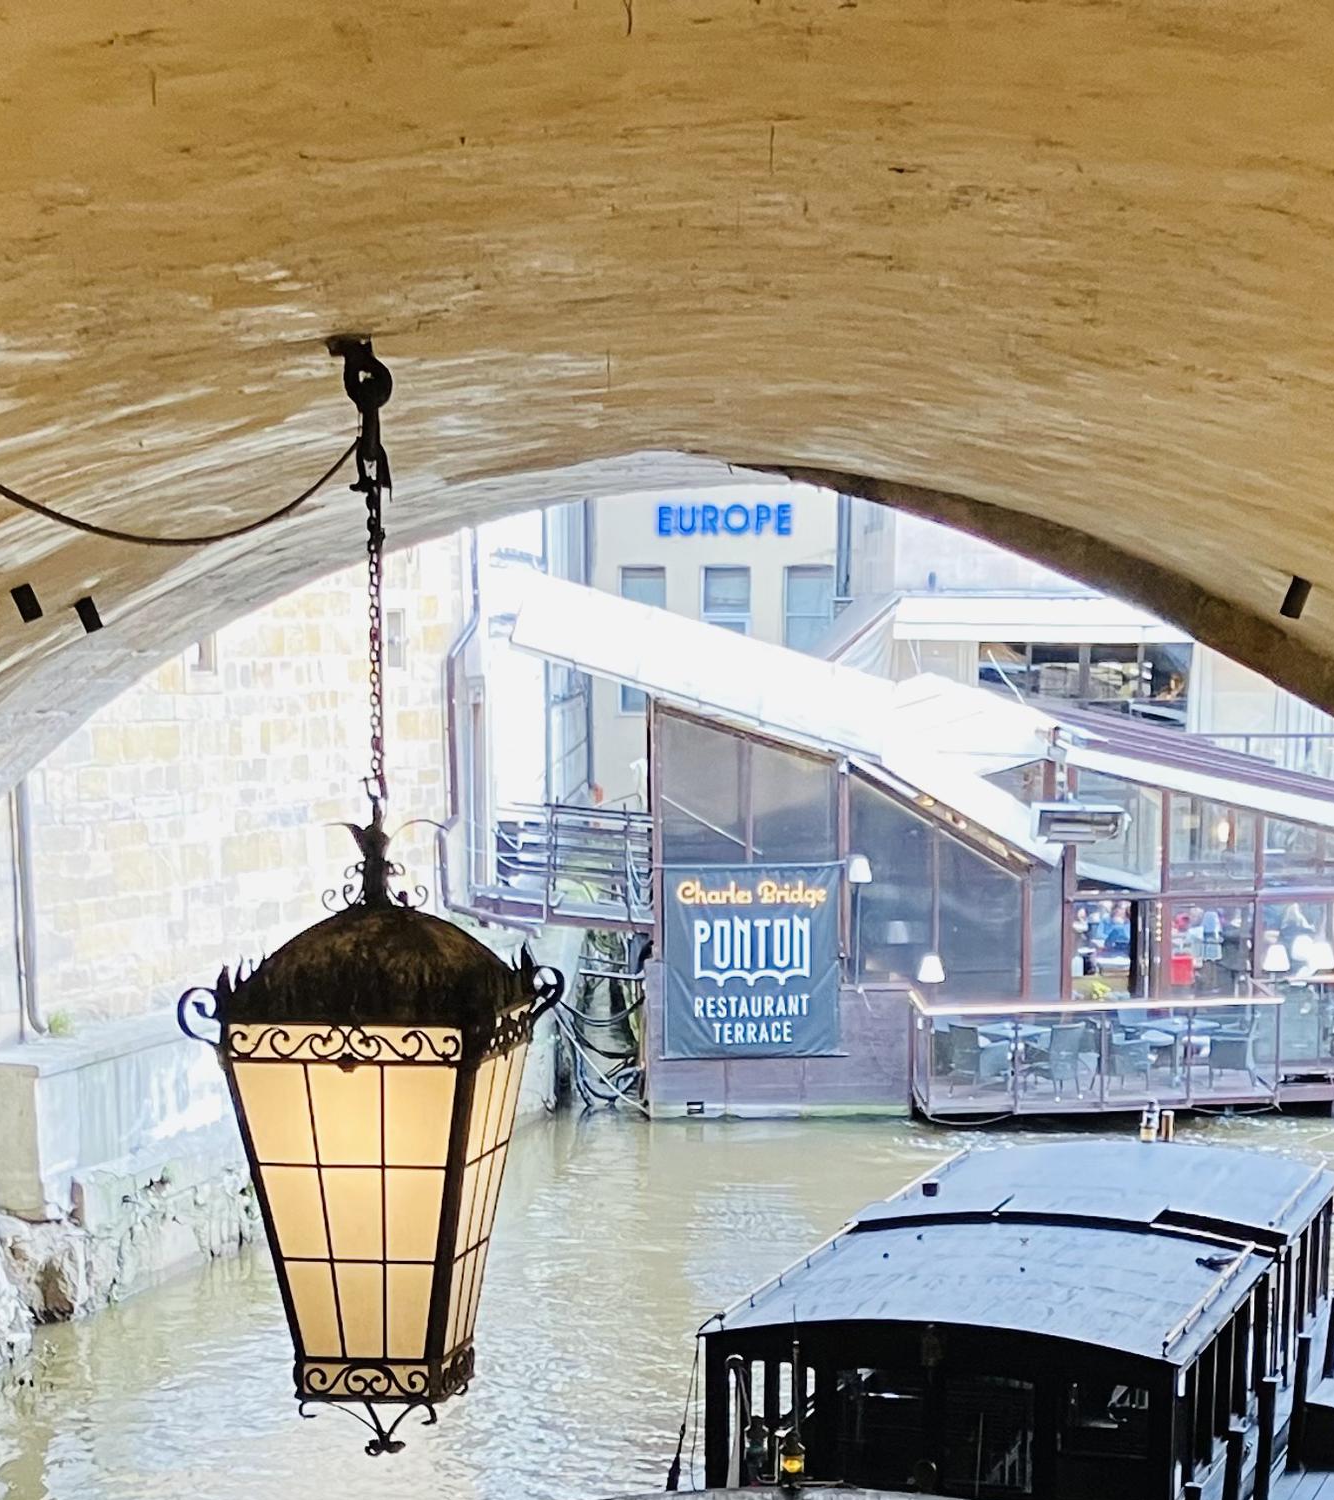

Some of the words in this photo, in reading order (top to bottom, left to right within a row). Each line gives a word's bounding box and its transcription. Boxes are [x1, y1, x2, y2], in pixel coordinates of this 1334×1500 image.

[657, 504, 793, 536] EUROPE
[677, 880, 753, 905] Charles
[758, 880, 827, 908] Bridge
[693, 914, 811, 979] PONTON
[693, 994, 810, 1018] RESTAURANT
[713, 1021, 793, 1044] TERRACE
